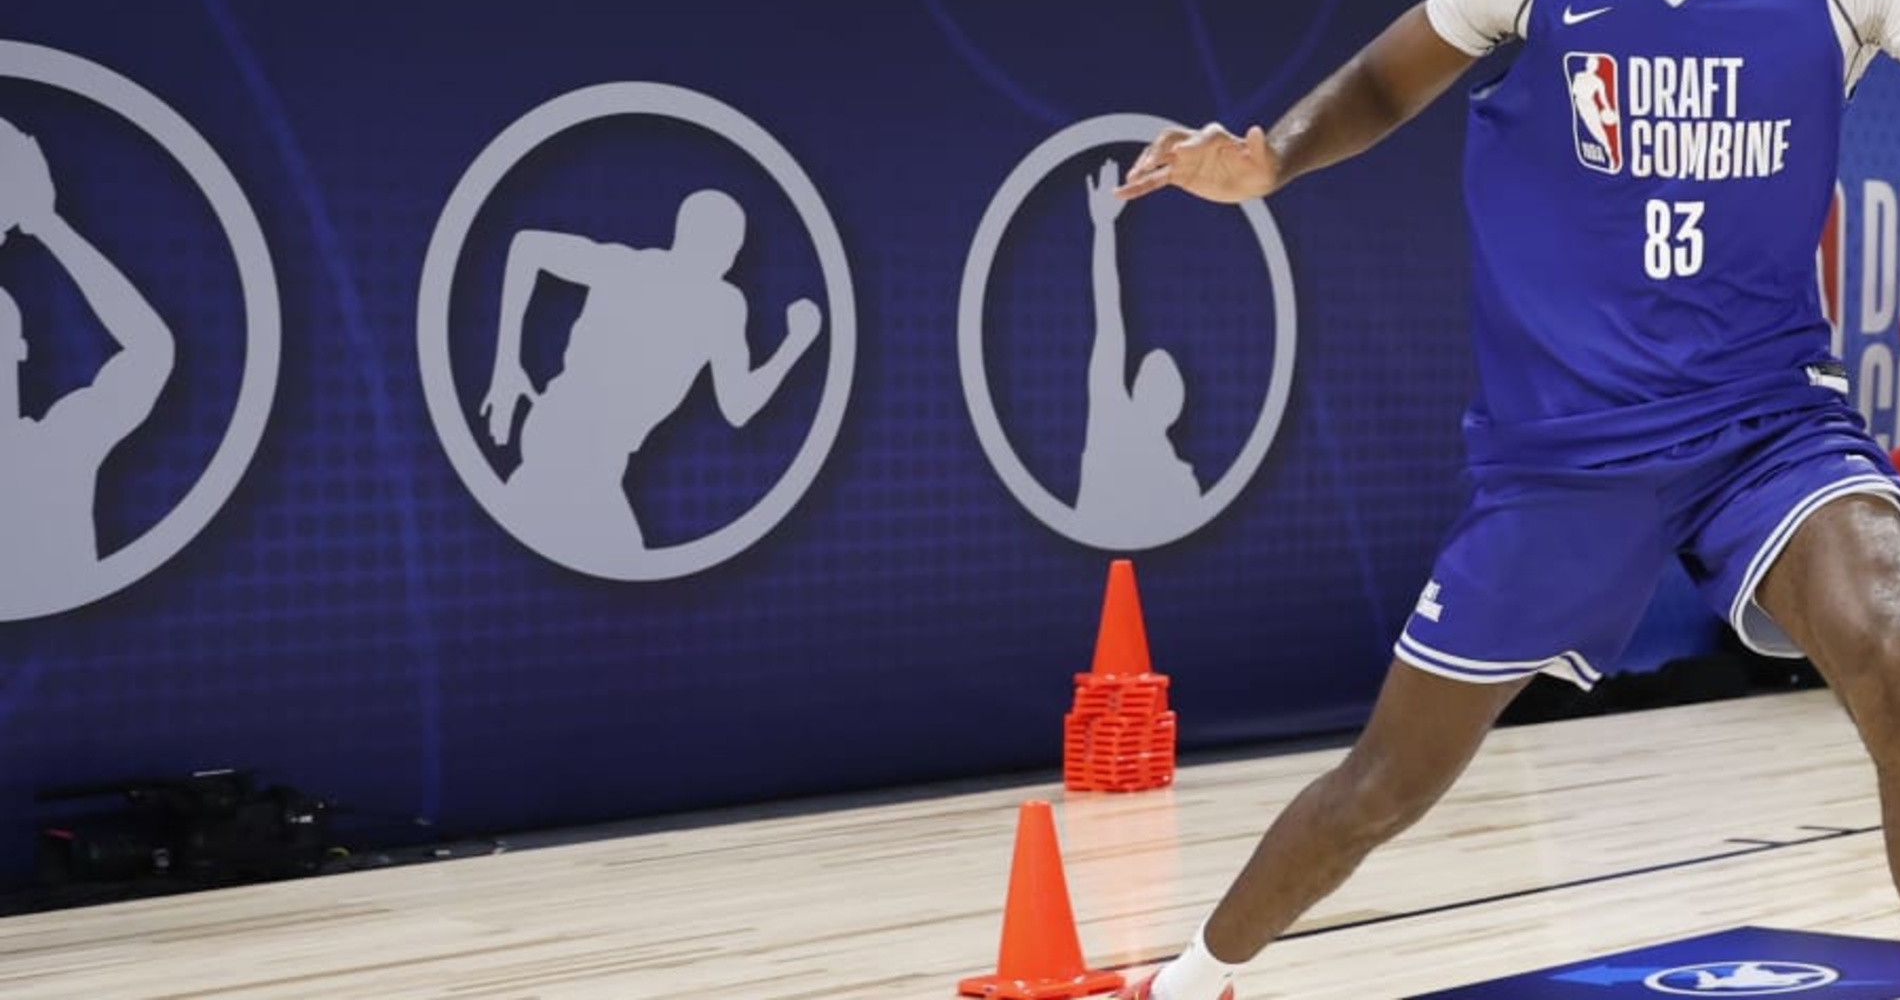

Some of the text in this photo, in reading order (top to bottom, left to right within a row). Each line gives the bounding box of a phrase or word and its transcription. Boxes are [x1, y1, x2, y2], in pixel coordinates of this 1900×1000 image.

[1628, 56, 1743, 118] DRAFT
[1630, 119, 1792, 181] COMBINE
[1644, 199, 1705, 279] 83
